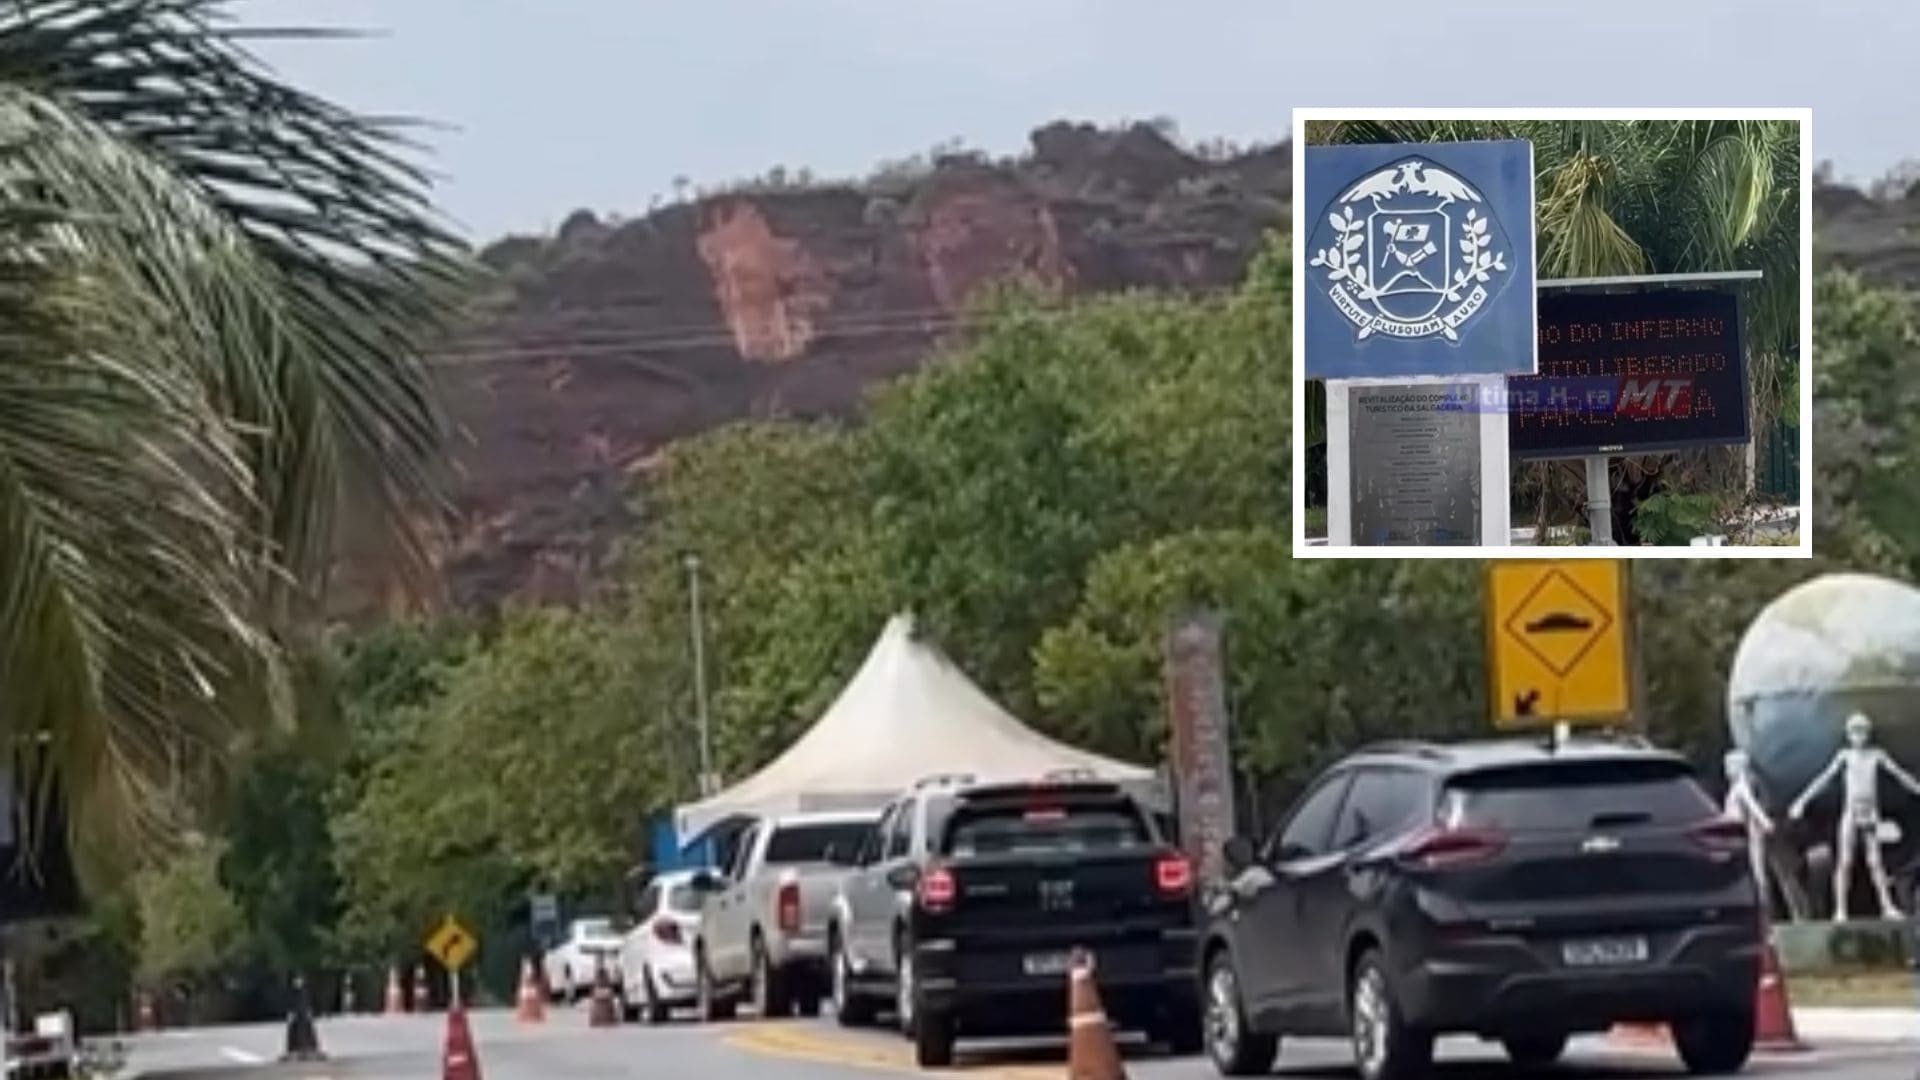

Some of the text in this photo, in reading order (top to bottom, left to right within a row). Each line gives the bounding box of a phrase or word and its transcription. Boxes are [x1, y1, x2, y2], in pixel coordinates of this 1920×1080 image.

[1332, 288, 1368, 325] VIRTUTE
[1452, 291, 1483, 324] AURO
[1570, 323, 1602, 343] DO
[1611, 317, 1723, 341] INFERNO
[1600, 352, 1727, 377] LIBERADO
